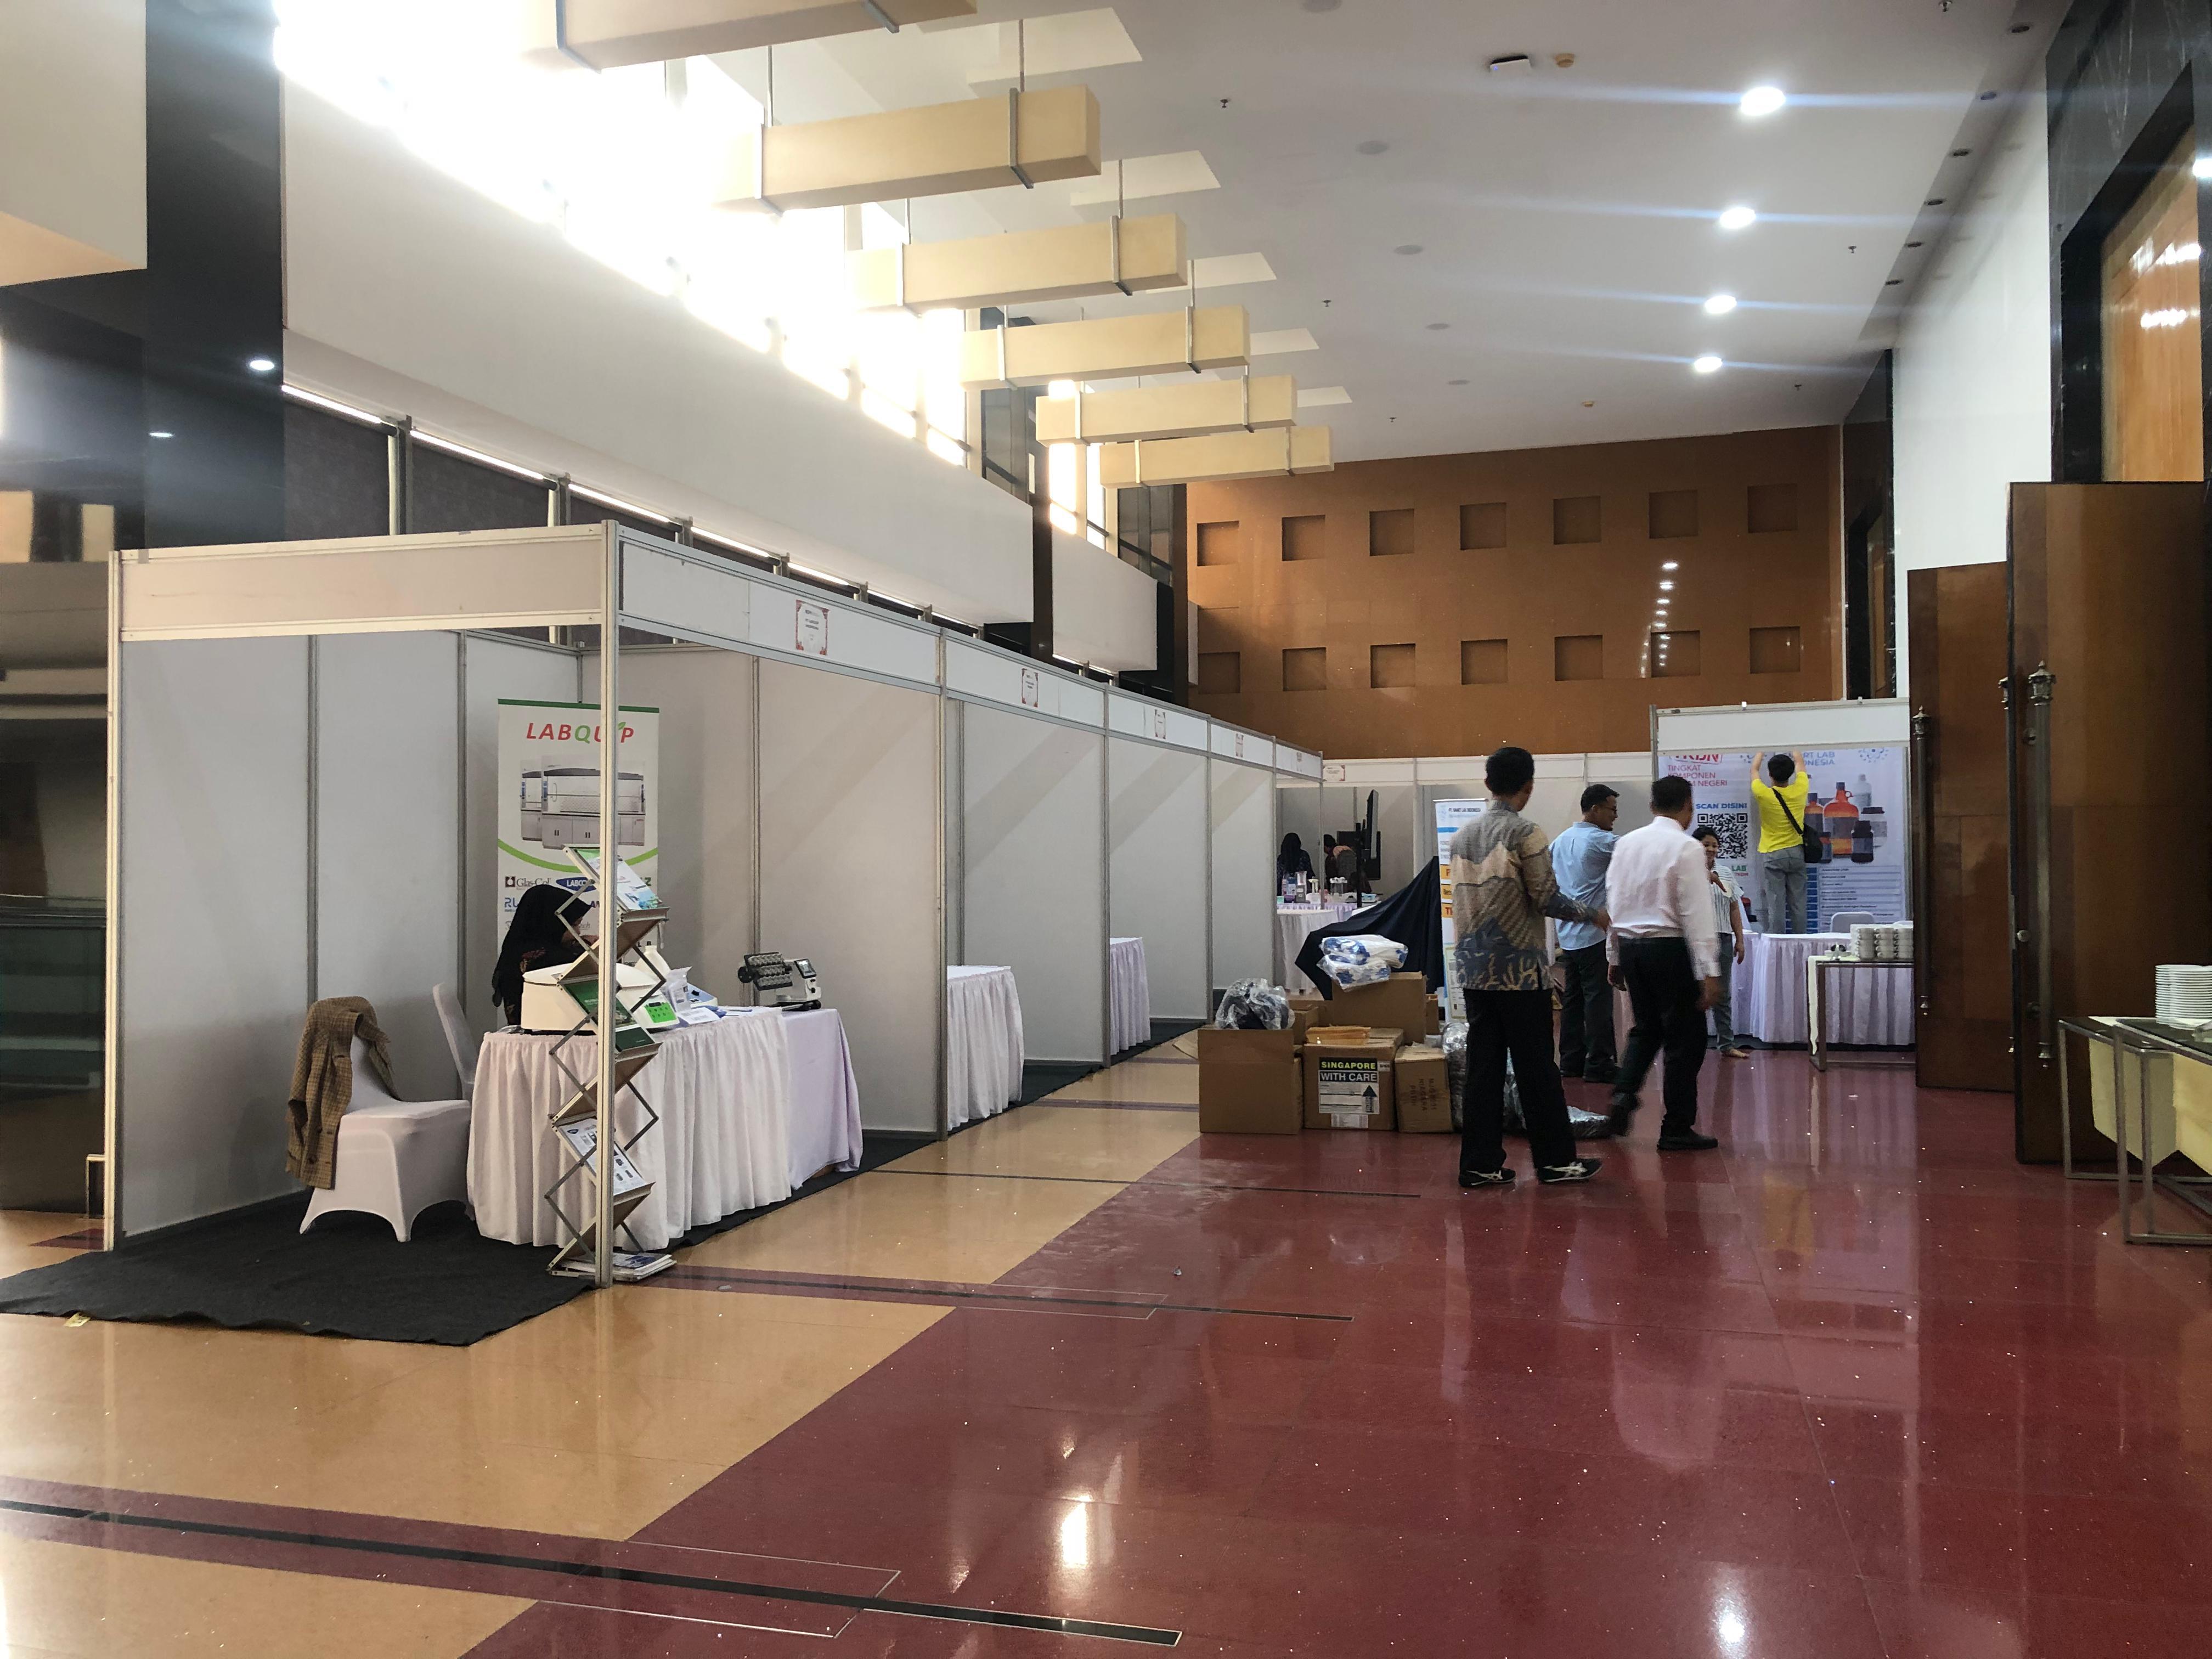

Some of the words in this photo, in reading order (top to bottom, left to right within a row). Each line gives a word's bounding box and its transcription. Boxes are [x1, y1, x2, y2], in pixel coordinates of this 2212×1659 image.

[526, 722, 634, 744] LABQUP
[1320, 1073, 1346, 1081] WITH
[1348, 1073, 1377, 1081] CARE
